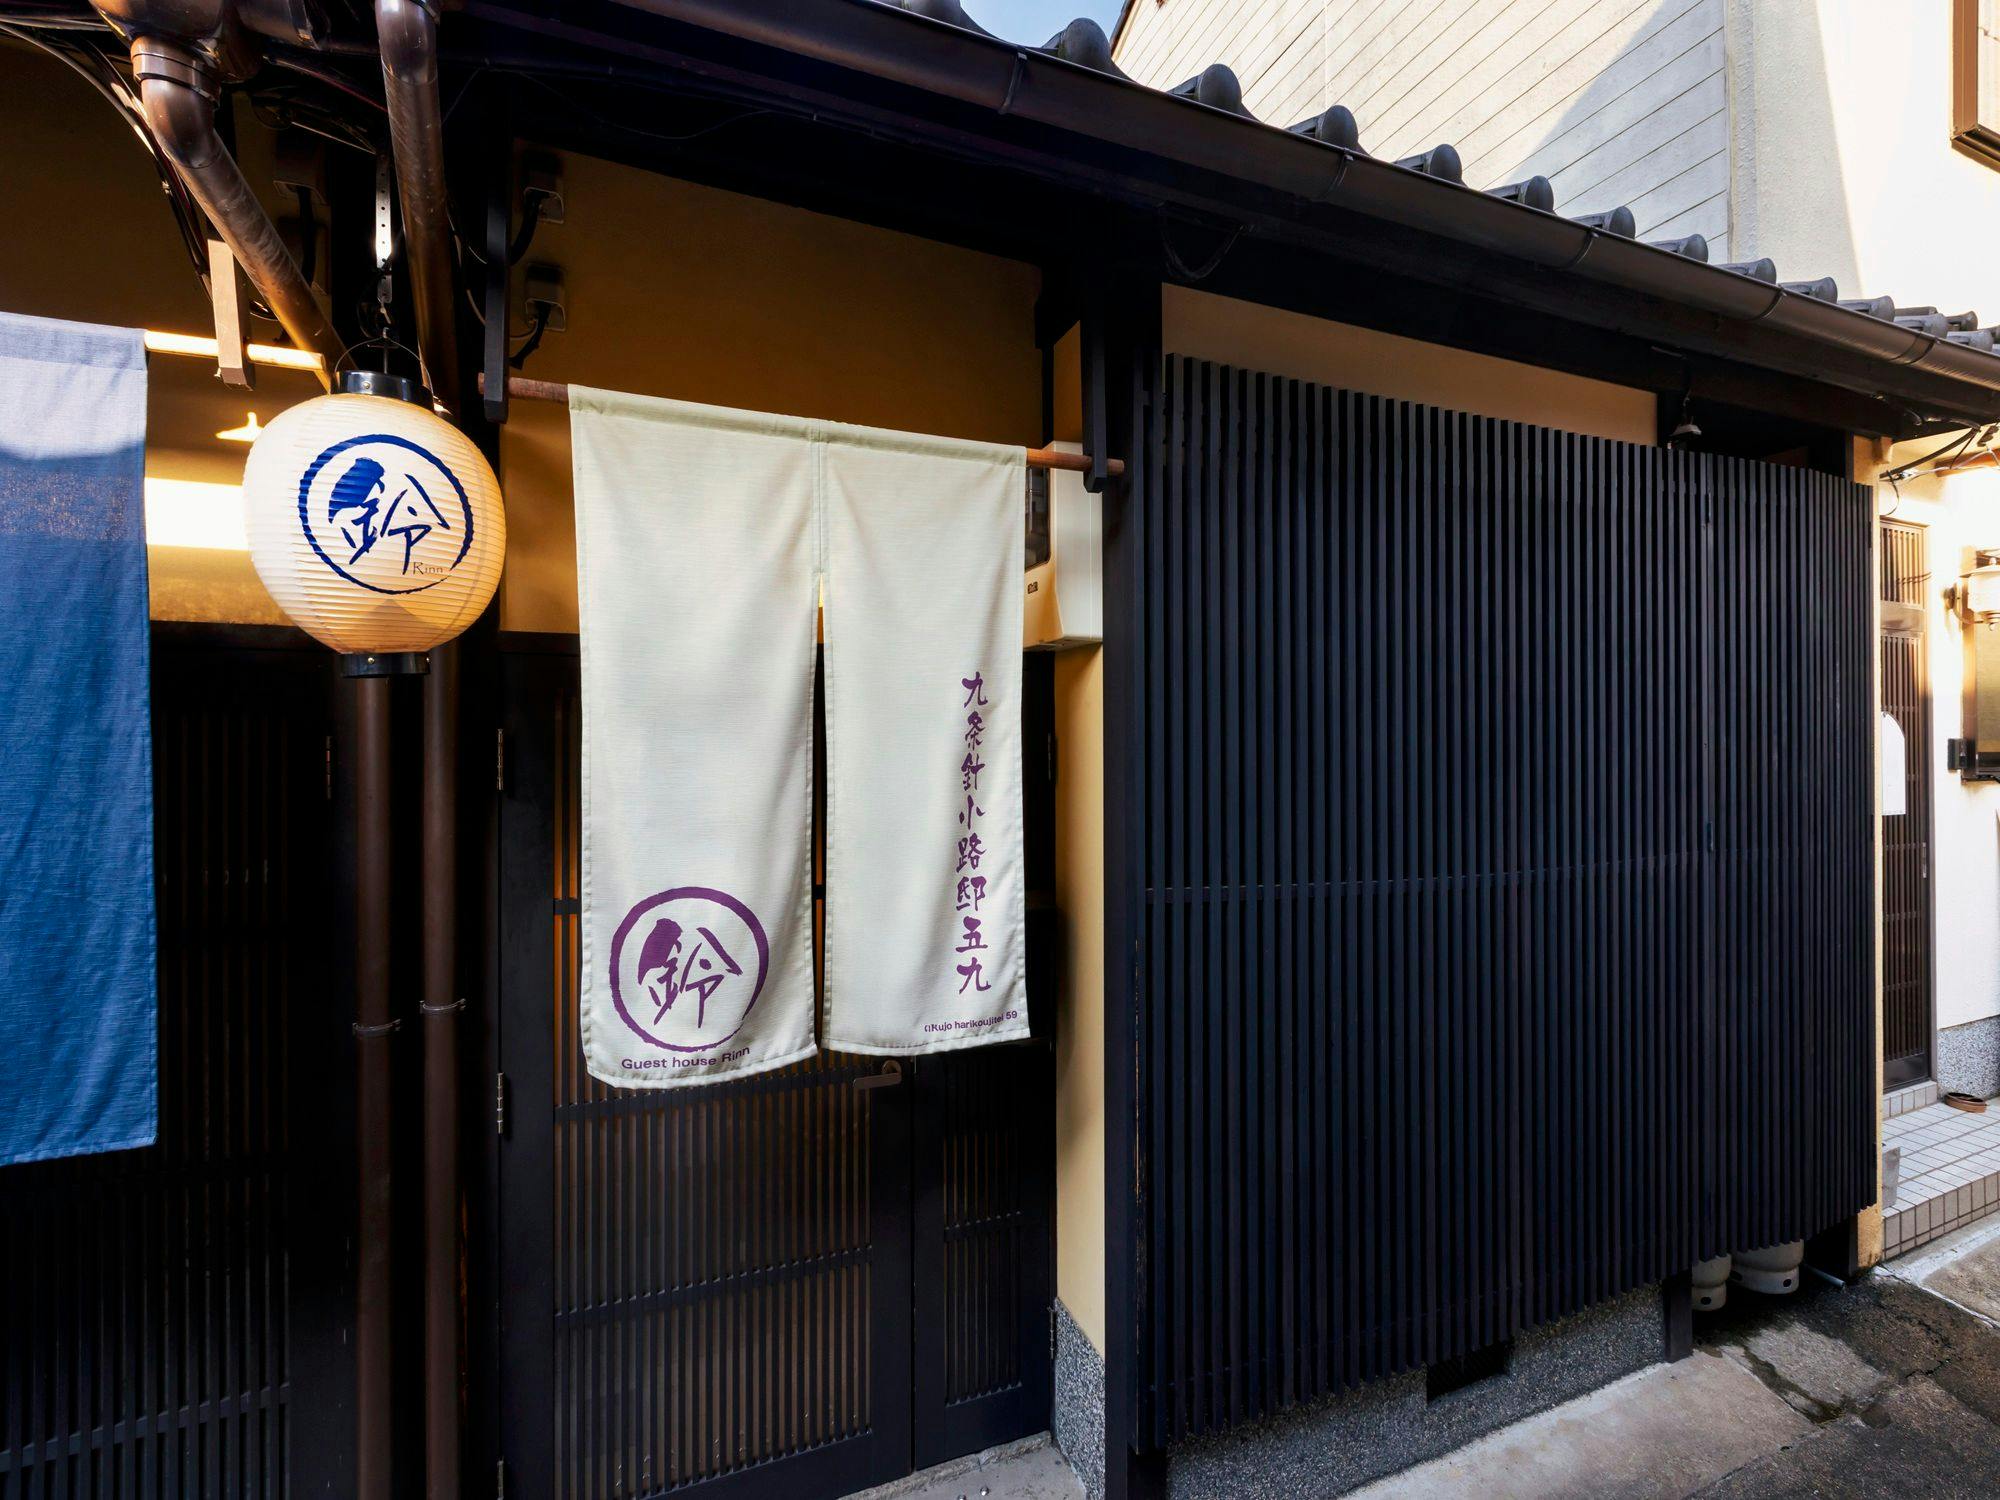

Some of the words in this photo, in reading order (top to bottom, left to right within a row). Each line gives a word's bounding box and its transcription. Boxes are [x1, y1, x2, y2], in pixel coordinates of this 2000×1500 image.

[328, 457, 450, 575] 鈴
[413, 561, 443, 575] Rinn
[638, 918, 743, 1028] 鈴
[1006, 1010, 1018, 1020] 59
[621, 1058, 668, 1070] Guest
[672, 1056, 717, 1068] house
[721, 1046, 750, 1063] Rinn
